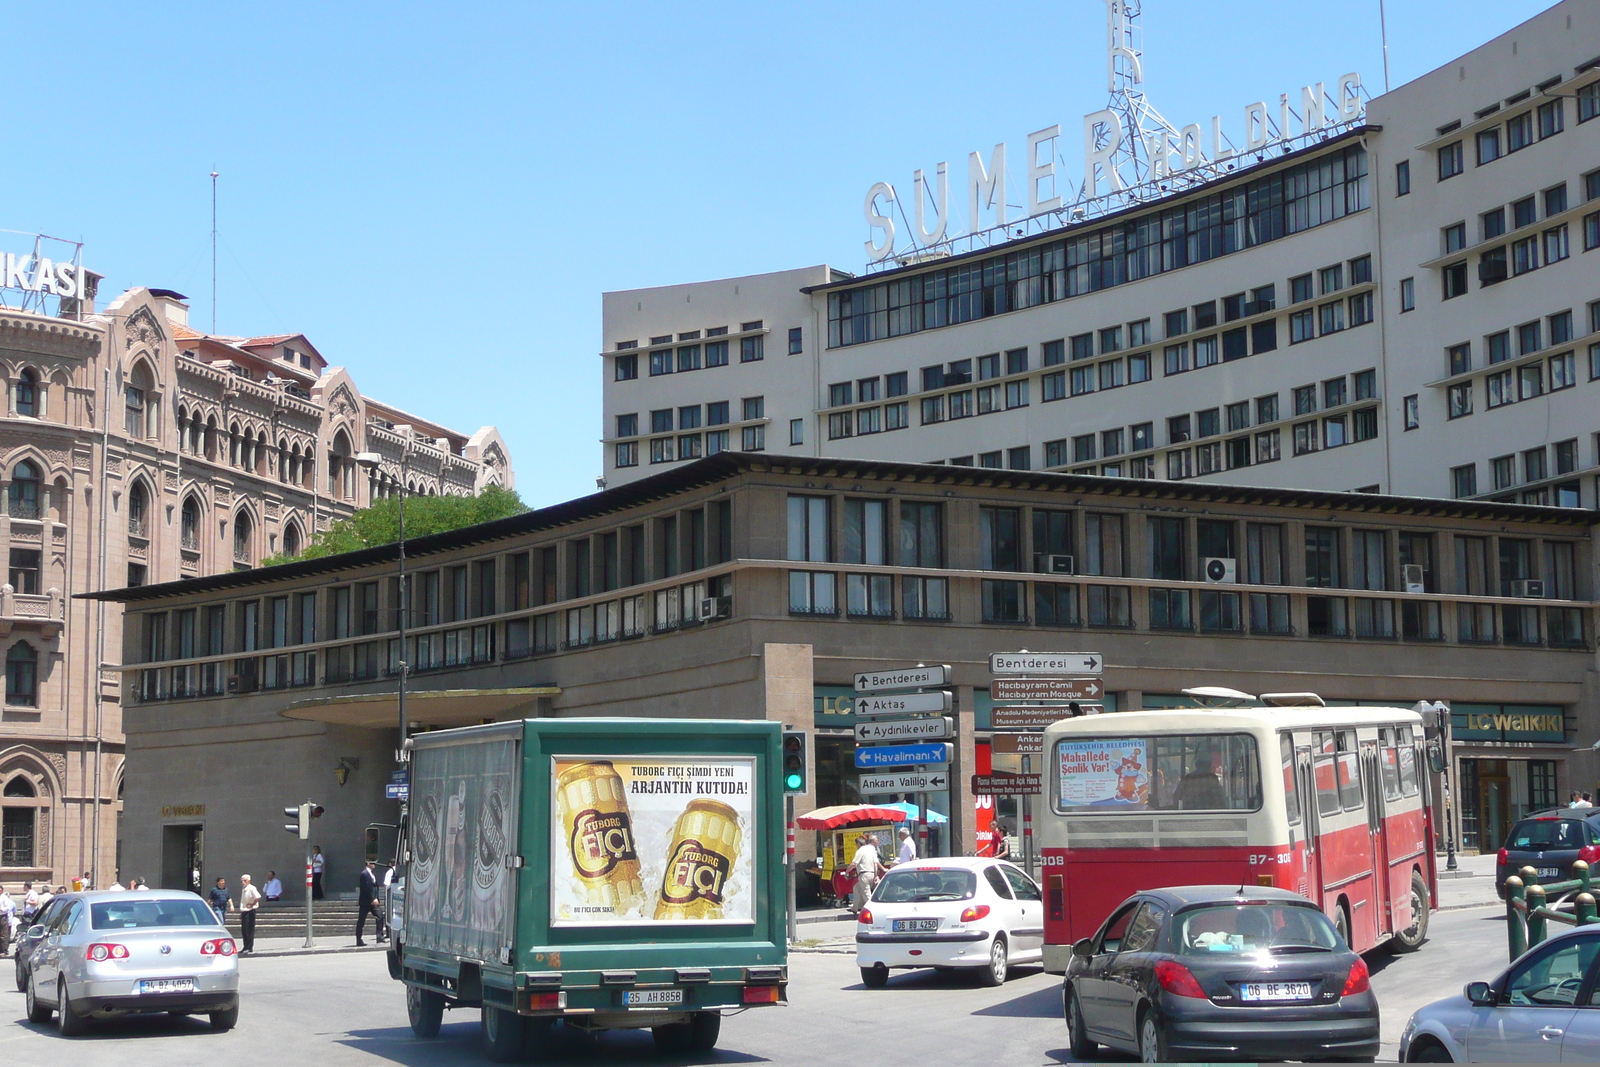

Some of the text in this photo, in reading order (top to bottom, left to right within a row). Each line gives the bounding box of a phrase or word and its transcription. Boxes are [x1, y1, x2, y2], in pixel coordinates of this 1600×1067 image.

[996, 658, 1067, 668] Bentderesi
[872, 671, 930, 686] Bentderesi
[1050, 691, 1082, 699] Mosque
[823, 696, 852, 715] LC
[873, 700, 905, 710] Aktaş
[1468, 713, 1491, 731] LC
[873, 724, 940, 738] Aydınlıkevler
[874, 752, 930, 763] Havalimanı
[1061, 751, 1110, 763] Mahallede
[631, 765, 734, 780] TUBORG FIÇI ŞİMDİ YENİ
[1061, 762, 1110, 776] Şenlik Var!
[631, 777, 748, 795] ARJANTİN KUTUDA!
[862, 779, 895, 789] Ankara
[585, 817, 621, 832] TUBORG
[581, 827, 632, 861] FIÇI
[684, 851, 719, 867] TUBORG
[671, 862, 722, 896] FIÇI
[896, 921, 906, 929] 06
[145, 981, 155, 990] 34
[1248, 983, 1309, 996] 06 BE 3620
[629, 992, 640, 1003] 35
[647, 992, 658, 1002] AH
